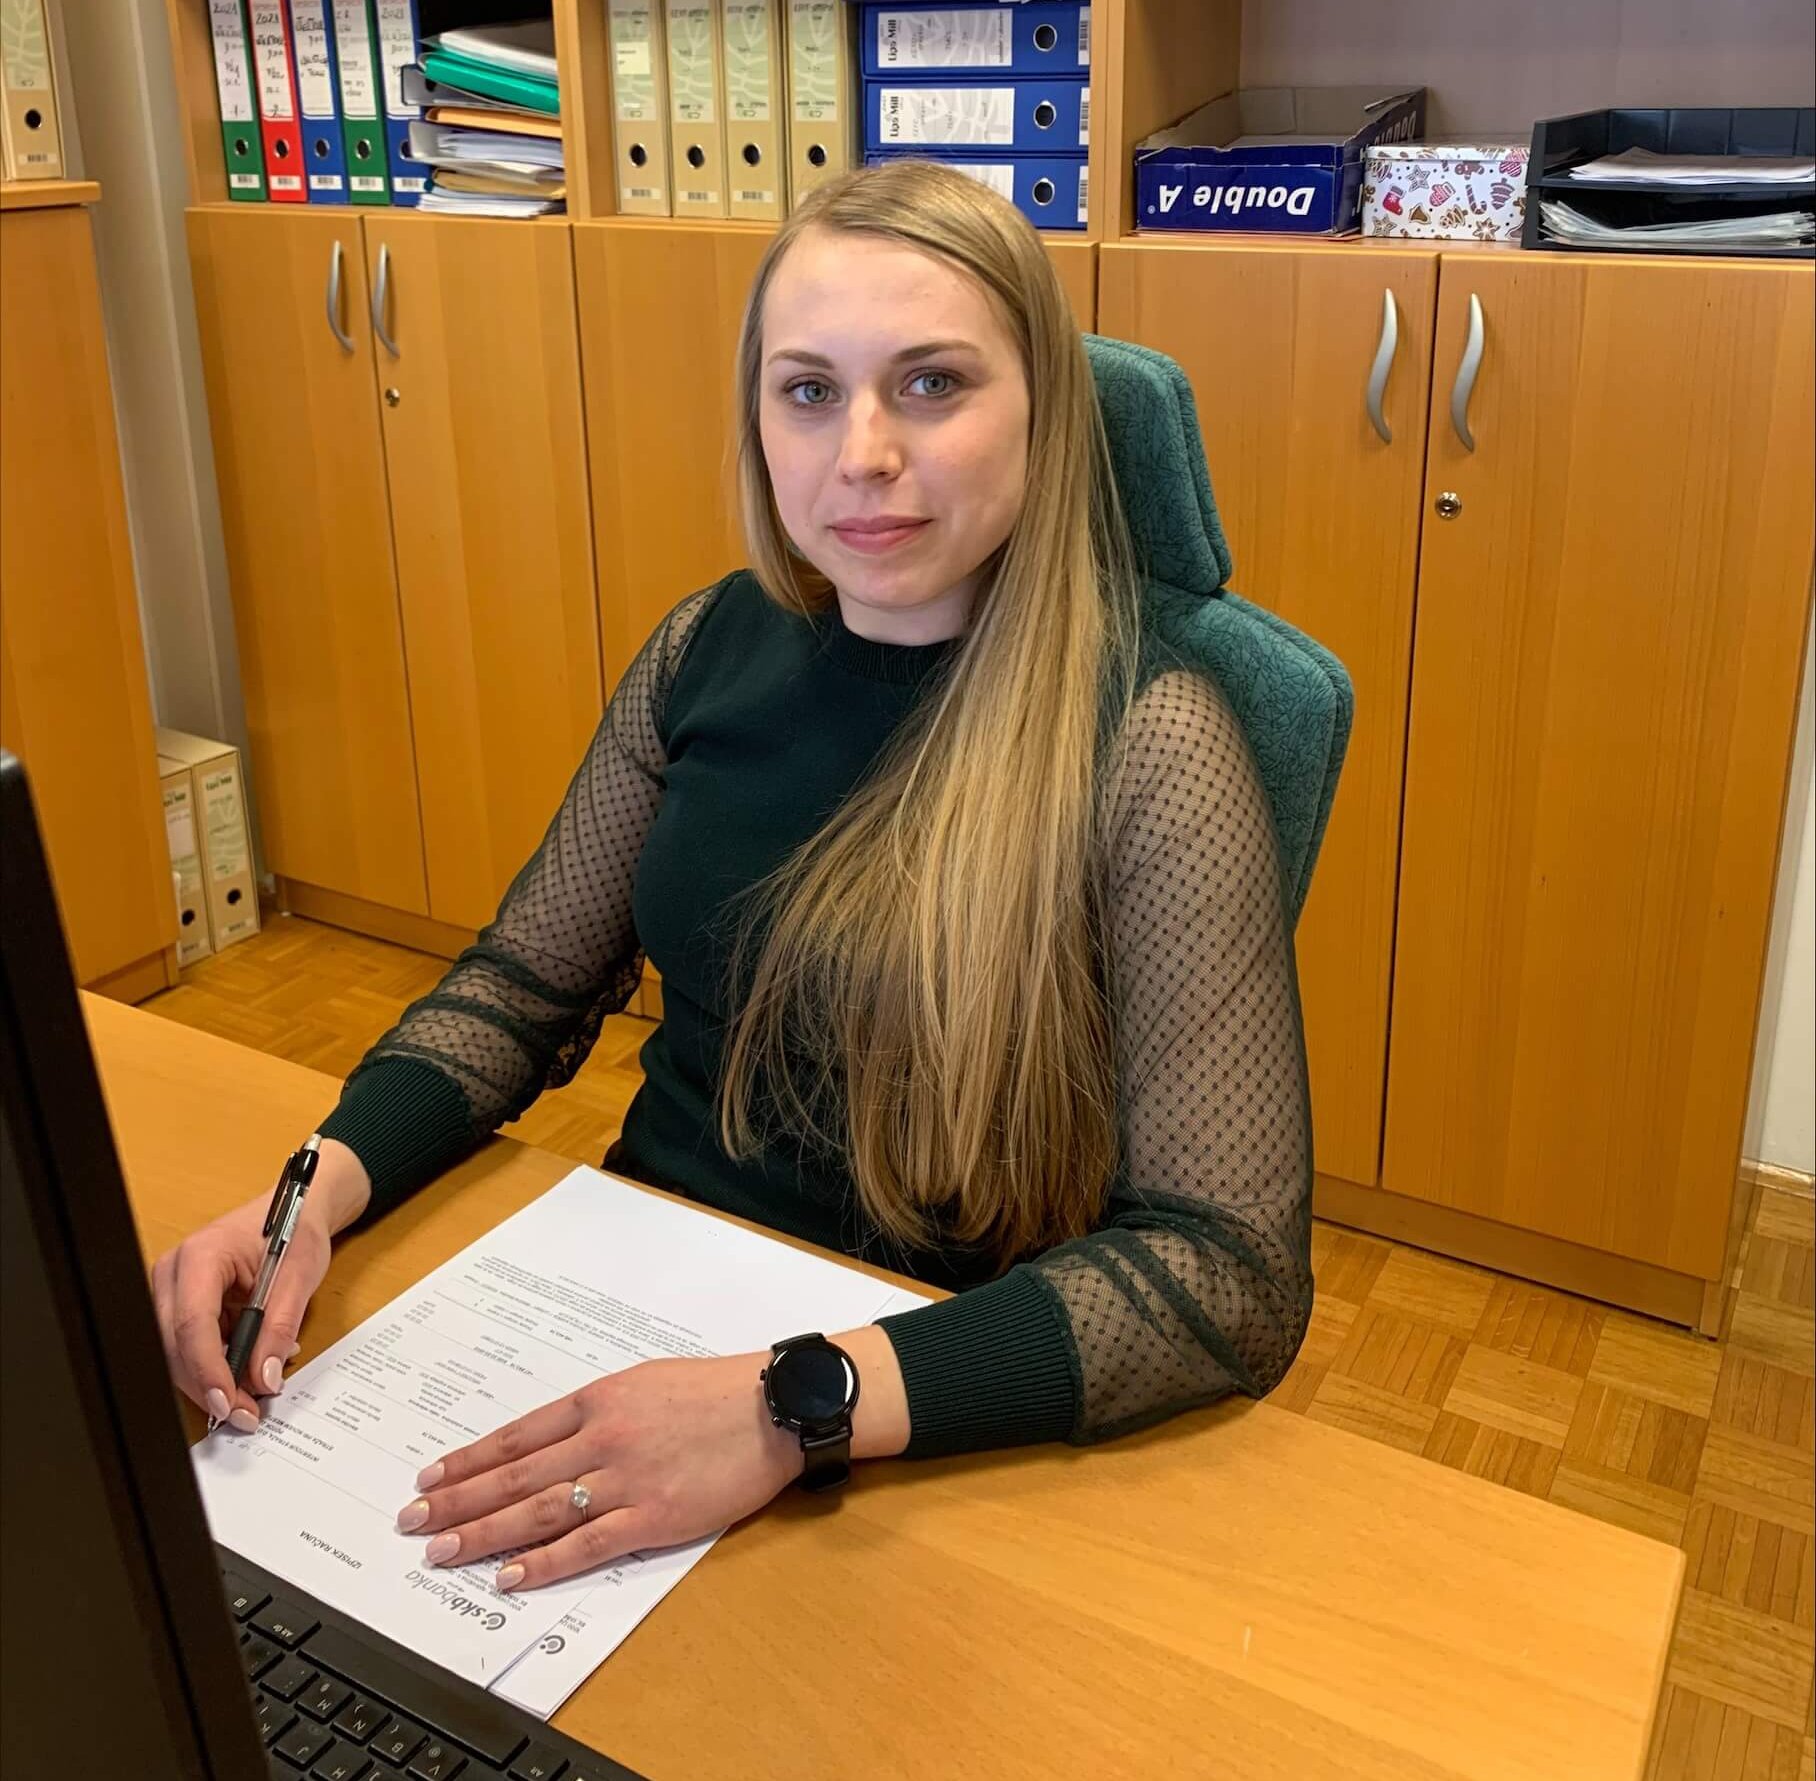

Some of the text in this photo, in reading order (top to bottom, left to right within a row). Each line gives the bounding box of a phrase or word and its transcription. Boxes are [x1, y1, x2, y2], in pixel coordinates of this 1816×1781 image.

[887, 19, 897, 38] Mill
[890, 96, 899, 114] Mill
[1193, 185, 1316, 216] Double
[298, 1531, 362, 1568] IZPISEK RAČUNA
[404, 1568, 488, 1618] skbbanka
